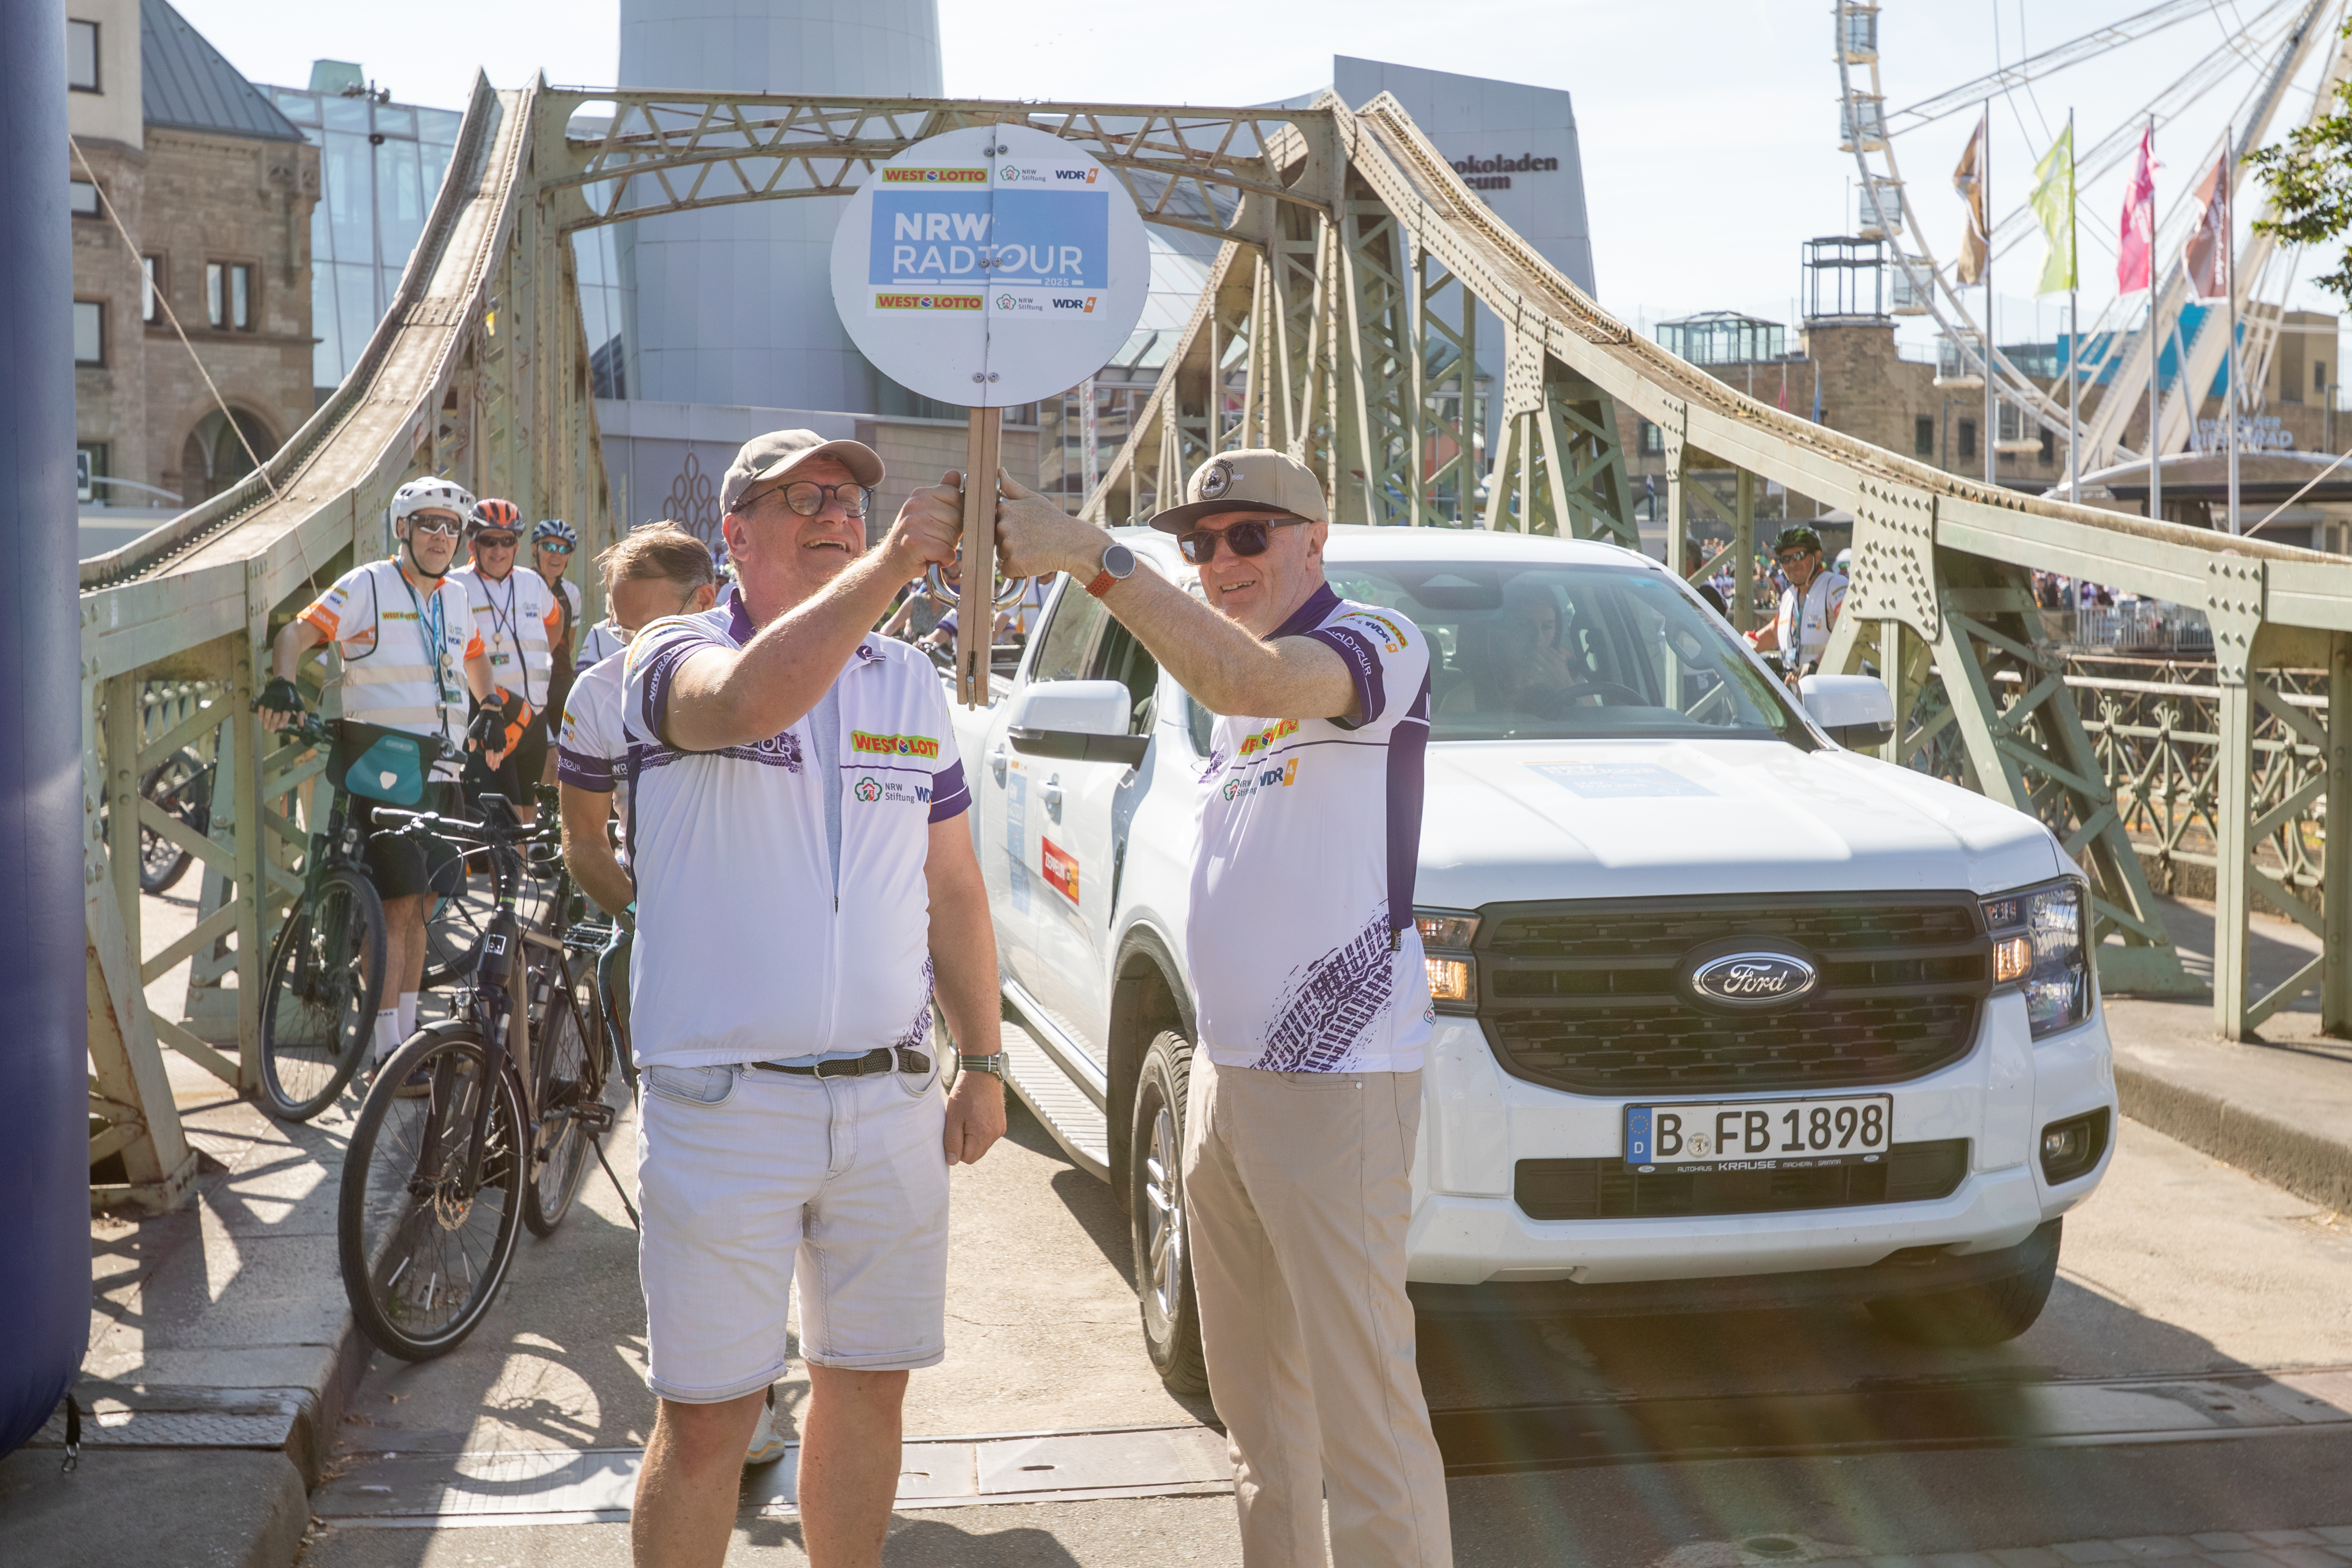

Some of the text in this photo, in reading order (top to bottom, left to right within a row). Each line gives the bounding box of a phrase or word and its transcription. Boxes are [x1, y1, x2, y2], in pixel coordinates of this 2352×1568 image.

[885, 170, 986, 181] WEST LOTTO
[1056, 170, 1085, 180] WDR
[894, 213, 991, 241] NRW
[893, 244, 1082, 274] RADTOUR
[1044, 278, 1069, 286] 2025
[878, 296, 981, 308] WEST LOTTO
[1052, 299, 1083, 309] WDR
[853, 734, 898, 753] WEST
[885, 783, 902, 791] NRW
[885, 792, 914, 804] Stiftung
[914, 785, 933, 803] WD
[1045, 851, 1065, 881] ZEPPELIN
[1723, 964, 1788, 993] Ford
[1657, 1105, 1883, 1156] B FB 1898
[1634, 1142, 1644, 1154] D
[1718, 1160, 1776, 1171] KRAUSE
